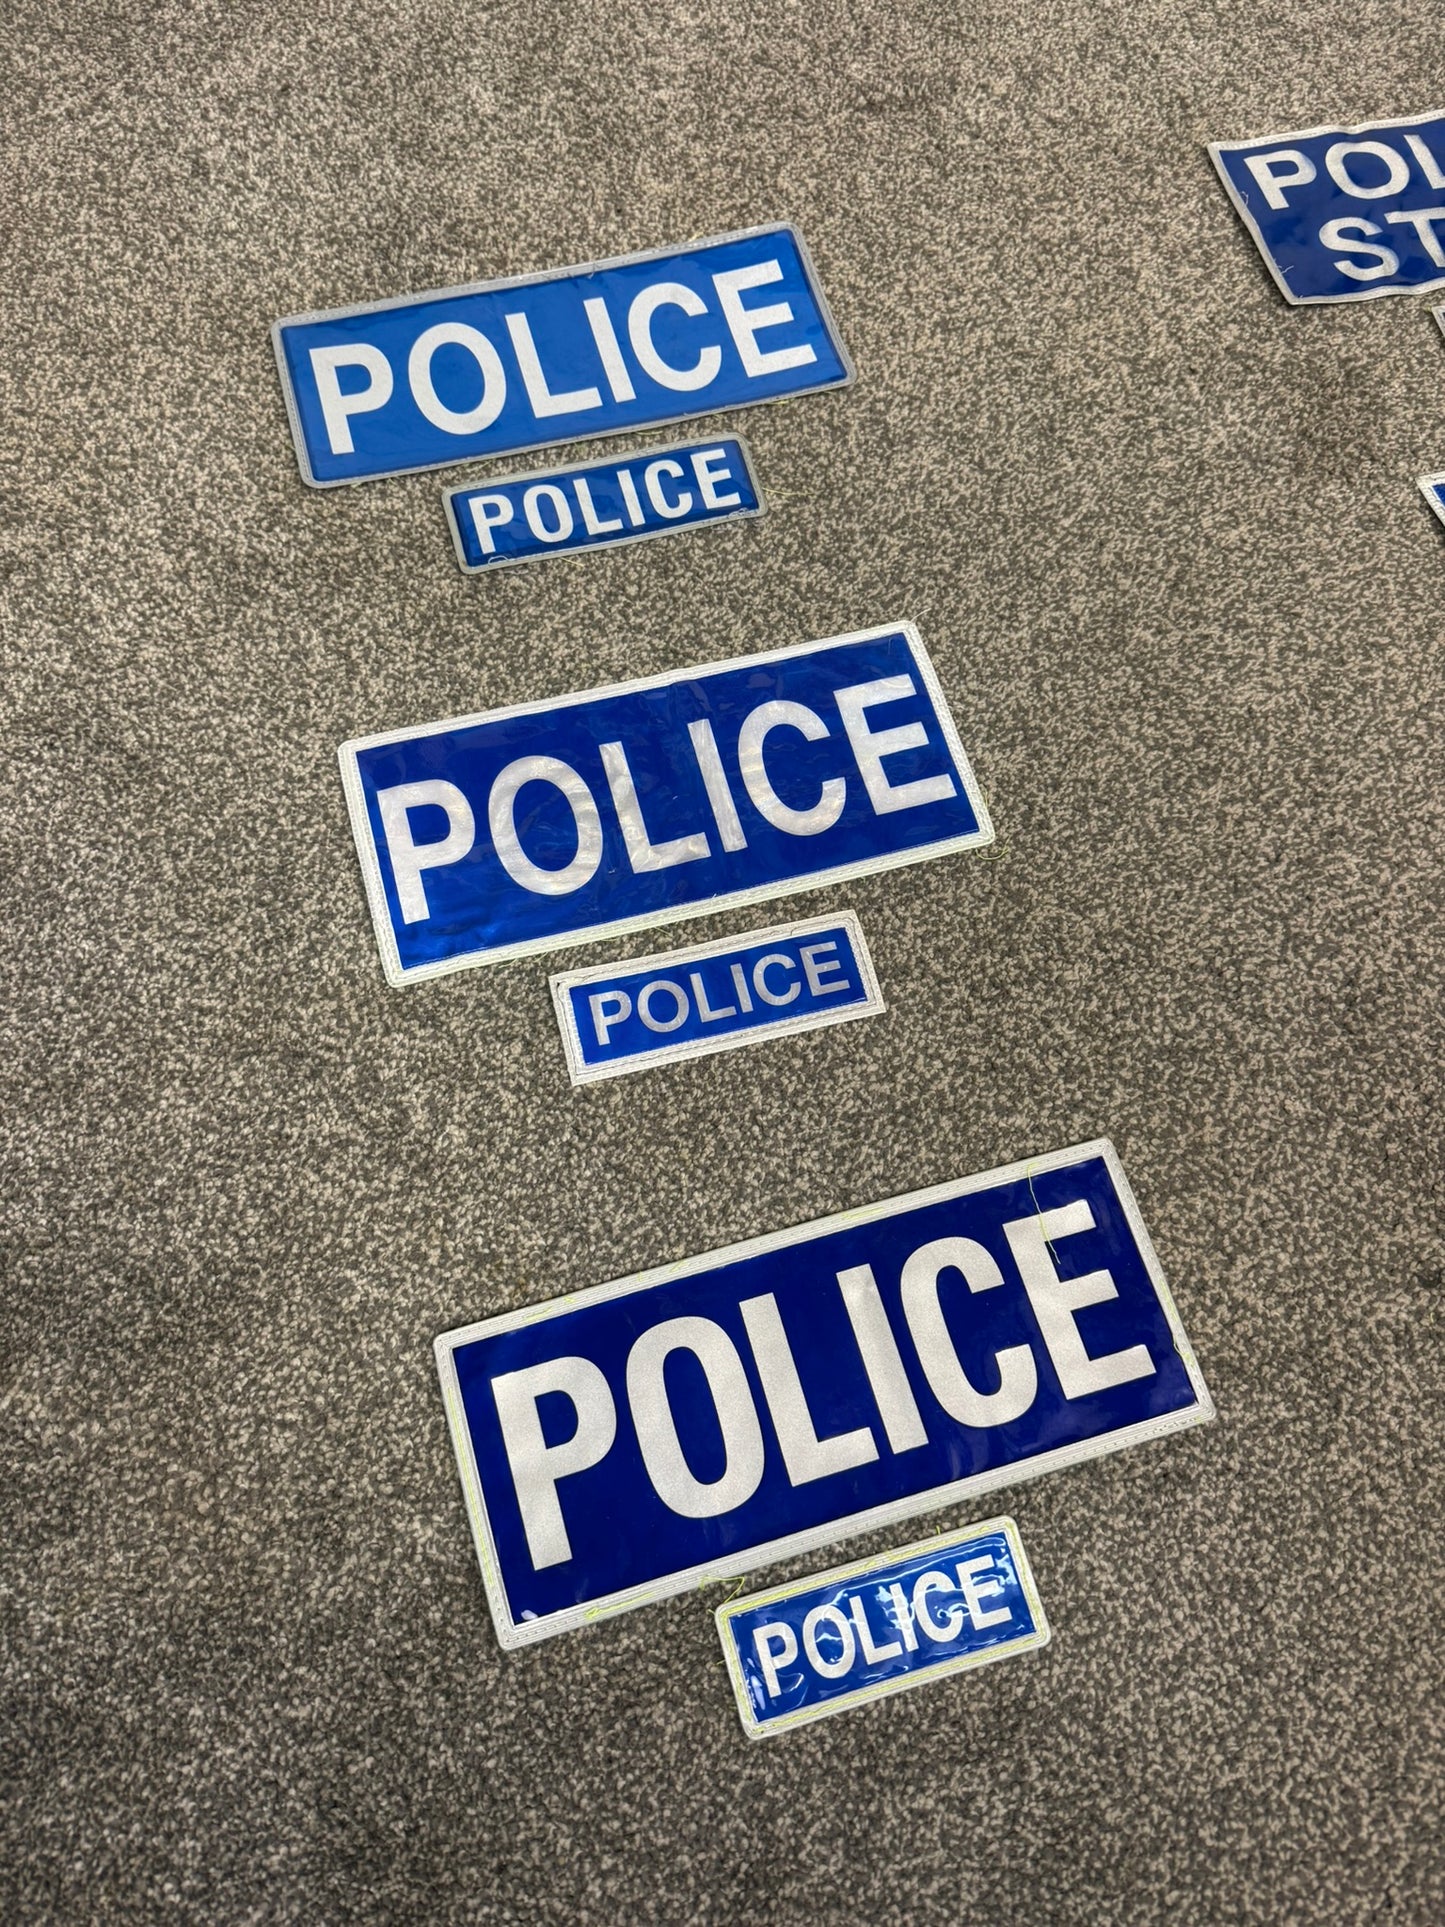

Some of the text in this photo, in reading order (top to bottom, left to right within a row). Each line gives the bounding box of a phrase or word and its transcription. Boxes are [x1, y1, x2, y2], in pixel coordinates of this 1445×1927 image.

[1318, 207, 1445, 282] ST
[308, 259, 818, 455] POLICE
[467, 449, 742, 553] POLICE
[376, 674, 957, 925] POLICE
[588, 941, 850, 1045] POLICE
[490, 1199, 1157, 1571] POLICE
[751, 1554, 1012, 1698] POLICE
